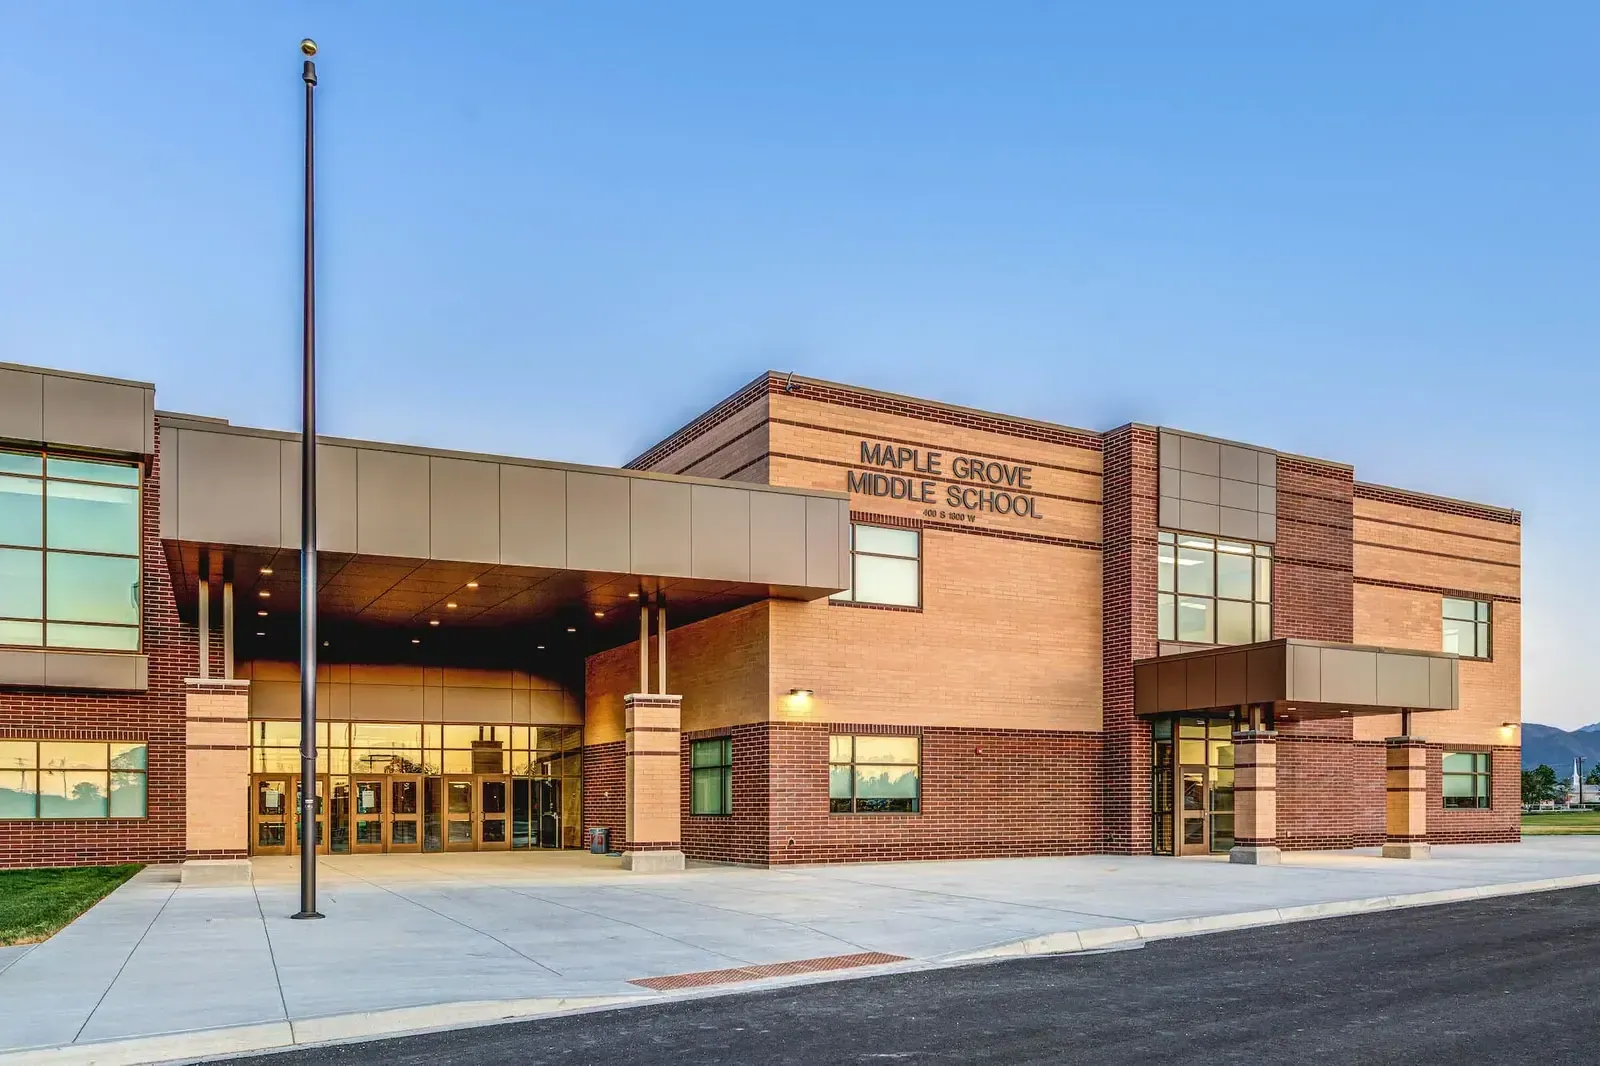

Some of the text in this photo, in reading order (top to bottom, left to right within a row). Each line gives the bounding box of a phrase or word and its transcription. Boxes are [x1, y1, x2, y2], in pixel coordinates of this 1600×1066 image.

[861, 441, 1032, 489] MAPLE GROVE
[847, 470, 1043, 519] MIDDLE SCHOOL
[923, 509, 937, 518] 400
[940, 511, 946, 519] S
[967, 514, 976, 523] W
